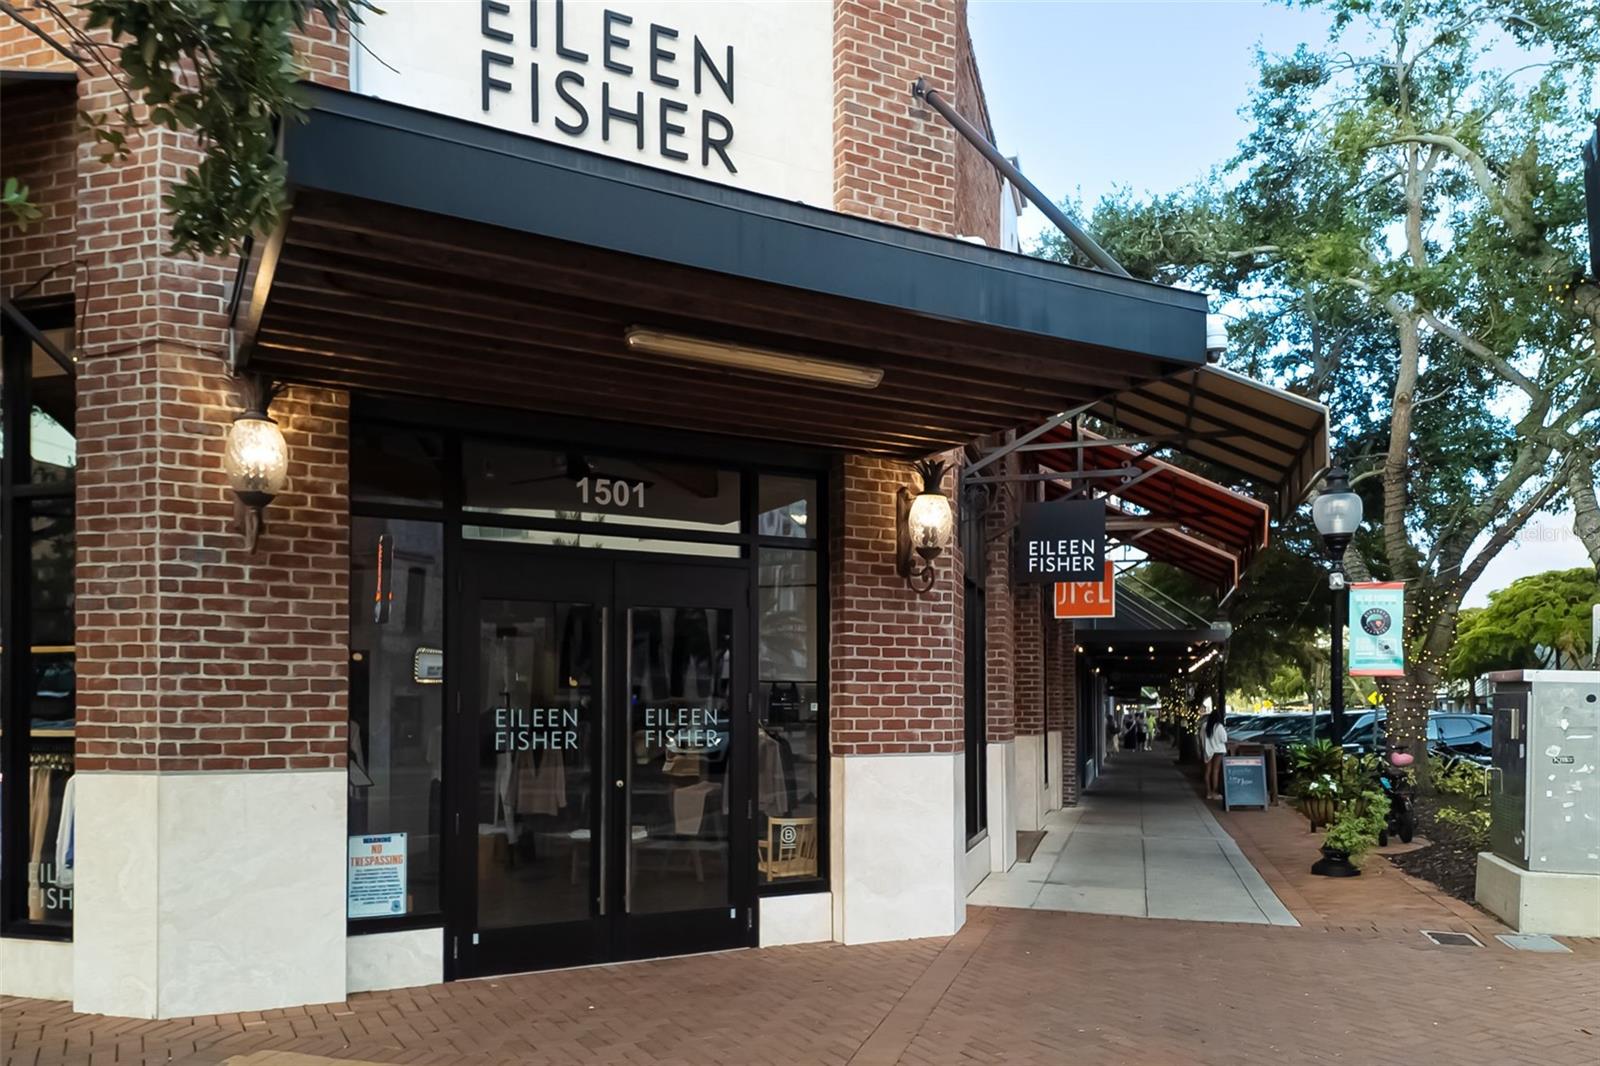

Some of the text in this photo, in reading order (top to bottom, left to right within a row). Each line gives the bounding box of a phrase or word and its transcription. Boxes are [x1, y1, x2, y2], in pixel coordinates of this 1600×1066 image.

[480, 0, 734, 105] EILEEN
[480, 49, 738, 174] FISHER
[576, 476, 645, 508] 1501
[1028, 539, 1096, 556] EILEEN
[1028, 556, 1096, 573] FISHER
[494, 708, 579, 728] EILEEN
[644, 708, 719, 727] EILEEN
[494, 731, 579, 751] FISHER
[644, 729, 719, 749] FISHER
